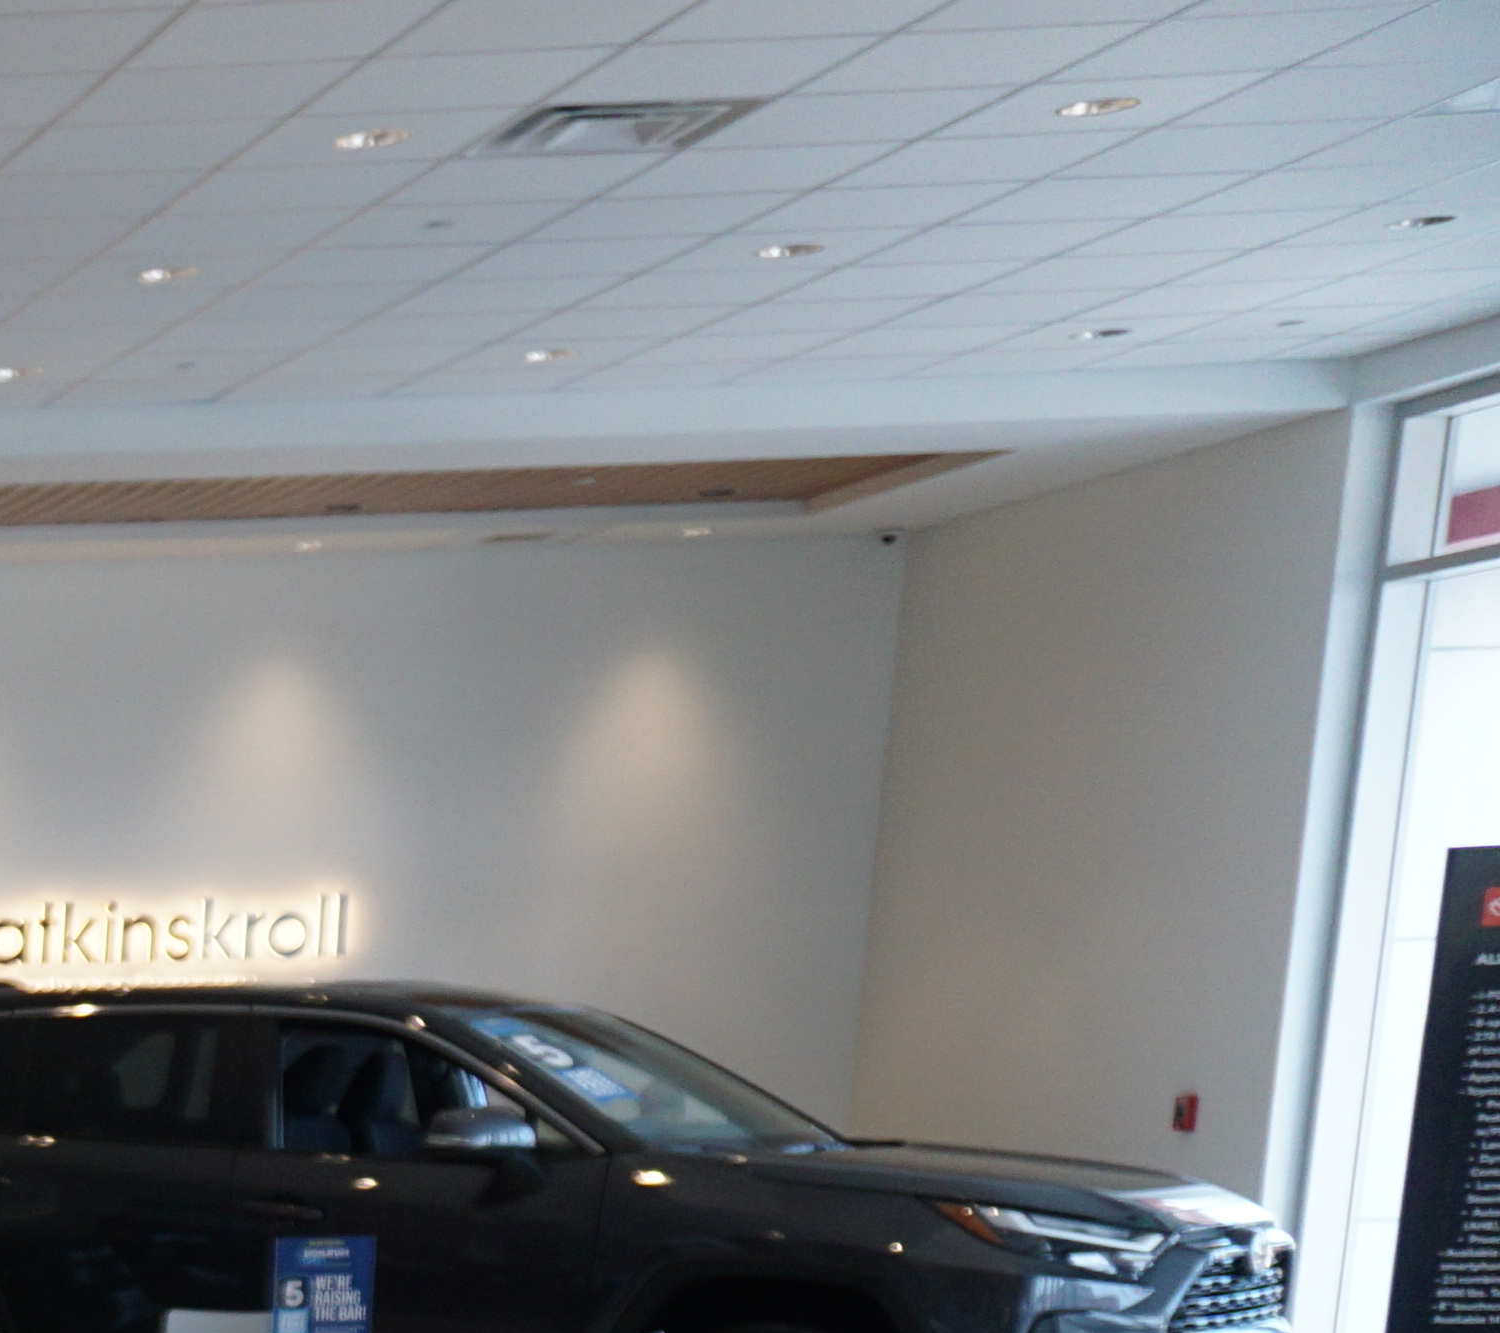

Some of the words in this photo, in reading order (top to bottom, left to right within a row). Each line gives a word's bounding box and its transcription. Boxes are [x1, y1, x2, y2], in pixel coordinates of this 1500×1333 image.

[511, 1035, 574, 1068] 5
[285, 1280, 304, 1307] 5
[315, 1305, 337, 1321] THE
